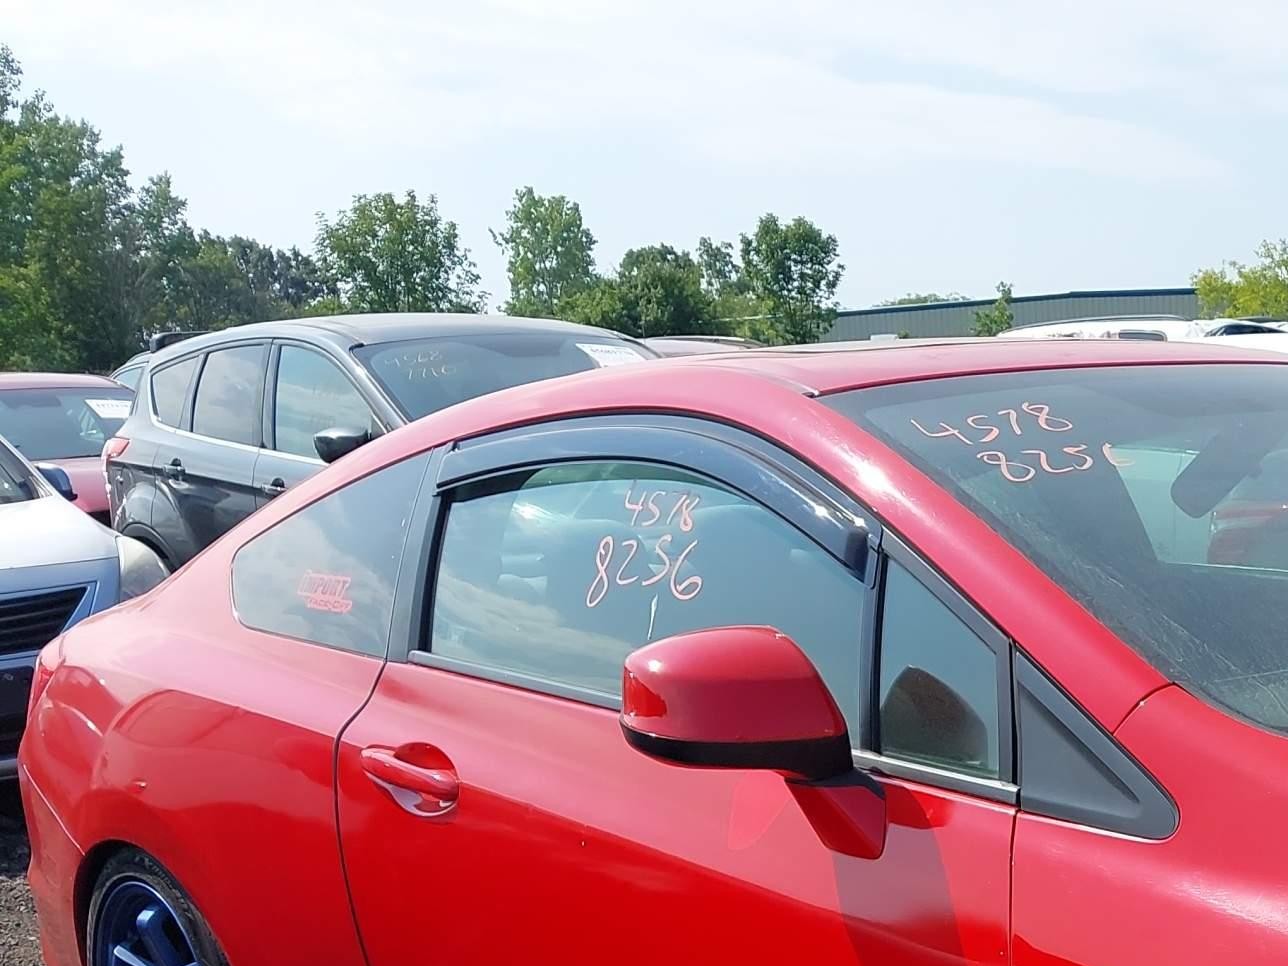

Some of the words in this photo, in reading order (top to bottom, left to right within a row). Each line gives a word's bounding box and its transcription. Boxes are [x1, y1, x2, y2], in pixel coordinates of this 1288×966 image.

[910, 401, 1073, 445] 4578
[624, 489, 700, 532] 4578
[586, 535, 703, 607] 8256
